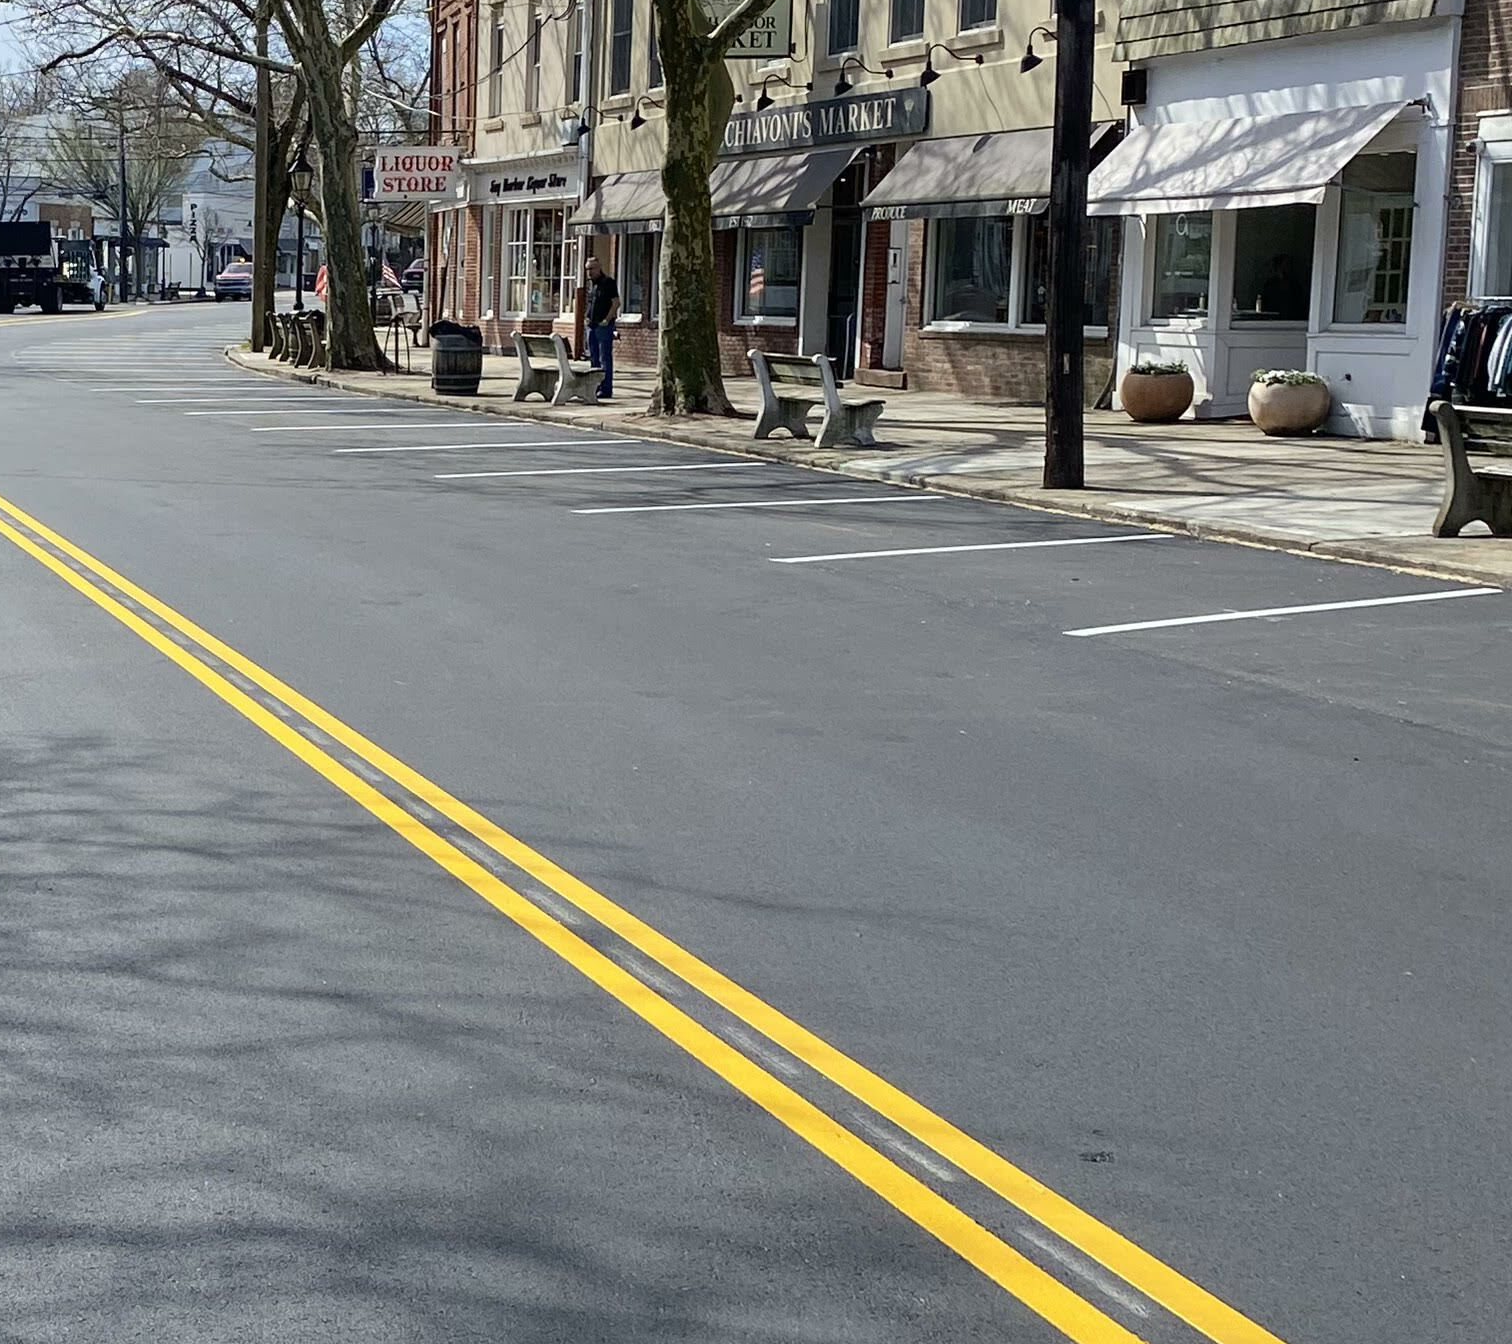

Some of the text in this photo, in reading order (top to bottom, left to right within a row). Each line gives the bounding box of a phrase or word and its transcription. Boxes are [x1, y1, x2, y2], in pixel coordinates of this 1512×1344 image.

[722, 97, 897, 148] CHIAVONI'S MARKET
[380, 155, 454, 173] LIQUOR
[382, 176, 447, 193] STORE
[1006, 199, 1037, 215] MEAT
[190, 203, 198, 243] PIZZA
